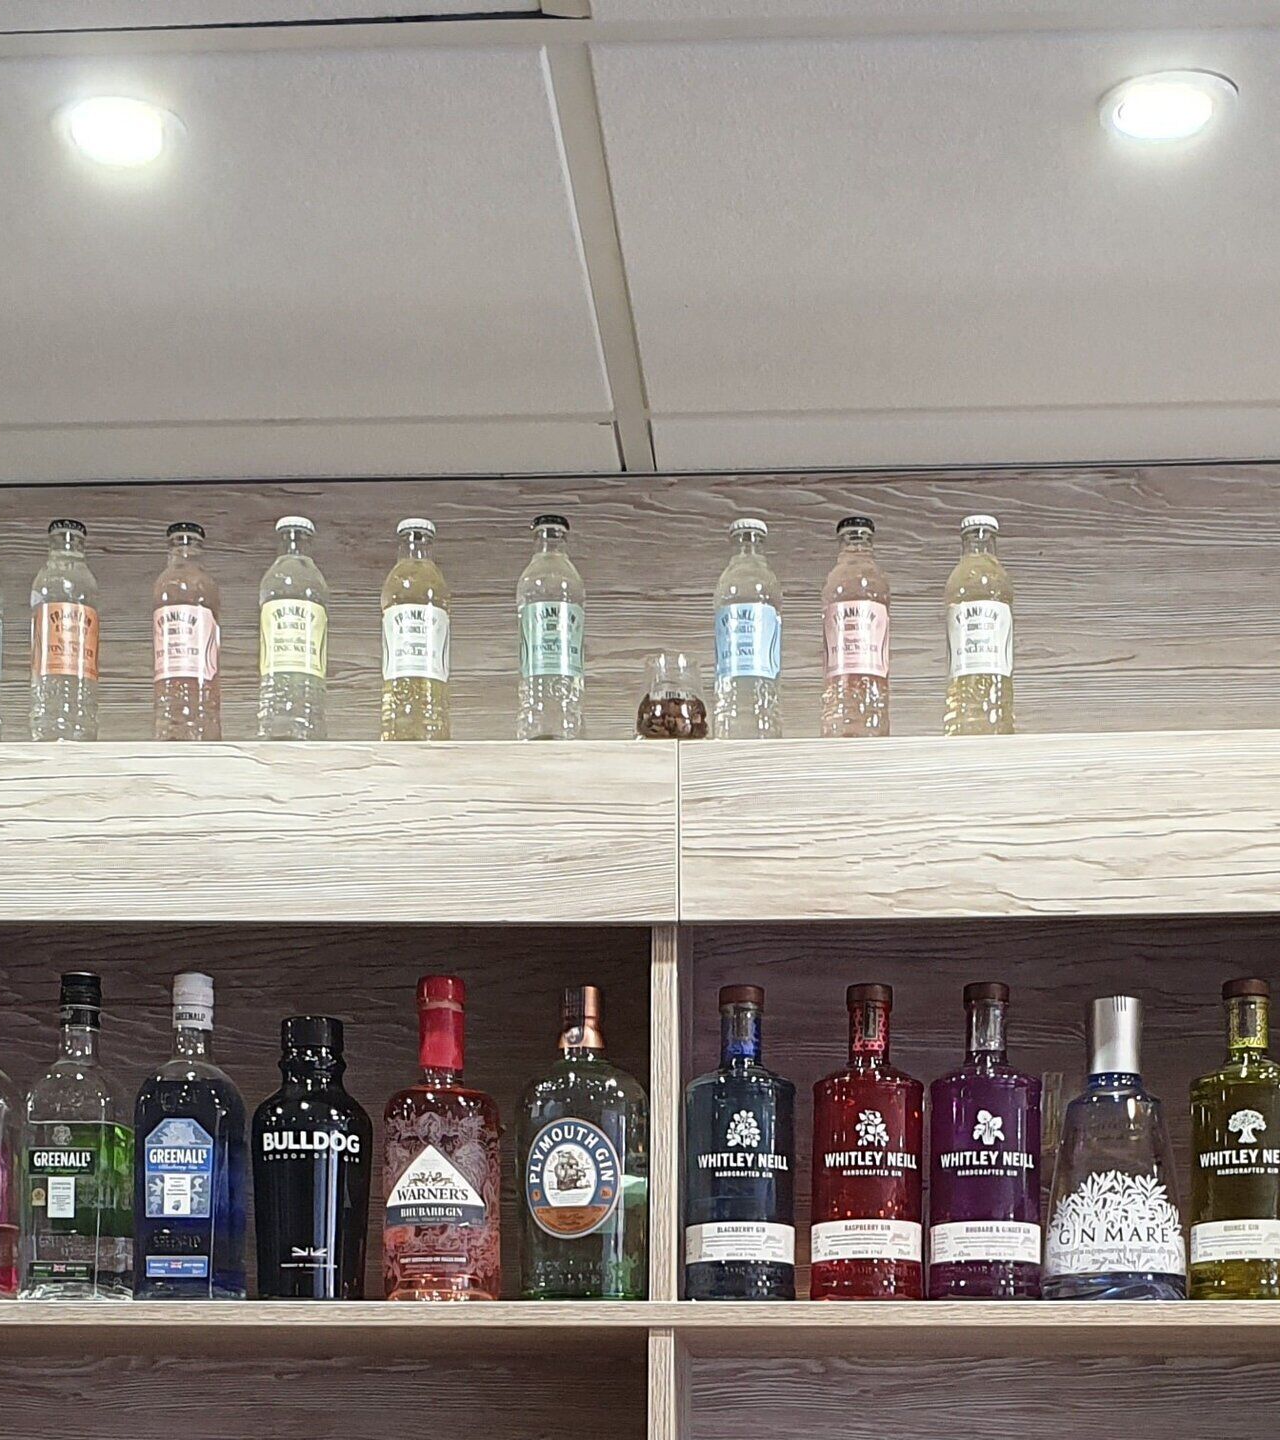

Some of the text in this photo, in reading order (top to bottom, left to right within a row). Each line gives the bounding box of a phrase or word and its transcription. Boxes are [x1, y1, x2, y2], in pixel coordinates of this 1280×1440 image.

[262, 1130, 361, 1154] BULLDOG
[33, 1151, 91, 1168] GREENALL'S
[149, 1148, 208, 1165] GREENALL'S
[263, 1153, 306, 1163] LONDON
[529, 1126, 614, 1184] PLYMOUTH GIN
[697, 1150, 788, 1171] WHITLEY NEILL
[824, 1151, 918, 1170] WHITLEY NEILL
[940, 1151, 1035, 1169] WHITLEY NEILL
[1200, 1149, 1258, 1168] WHITLEY
[396, 1186, 469, 1202] WARNER'S
[400, 1204, 463, 1217] RHUBARB GIN
[1103, 1226, 1171, 1244] MARE
